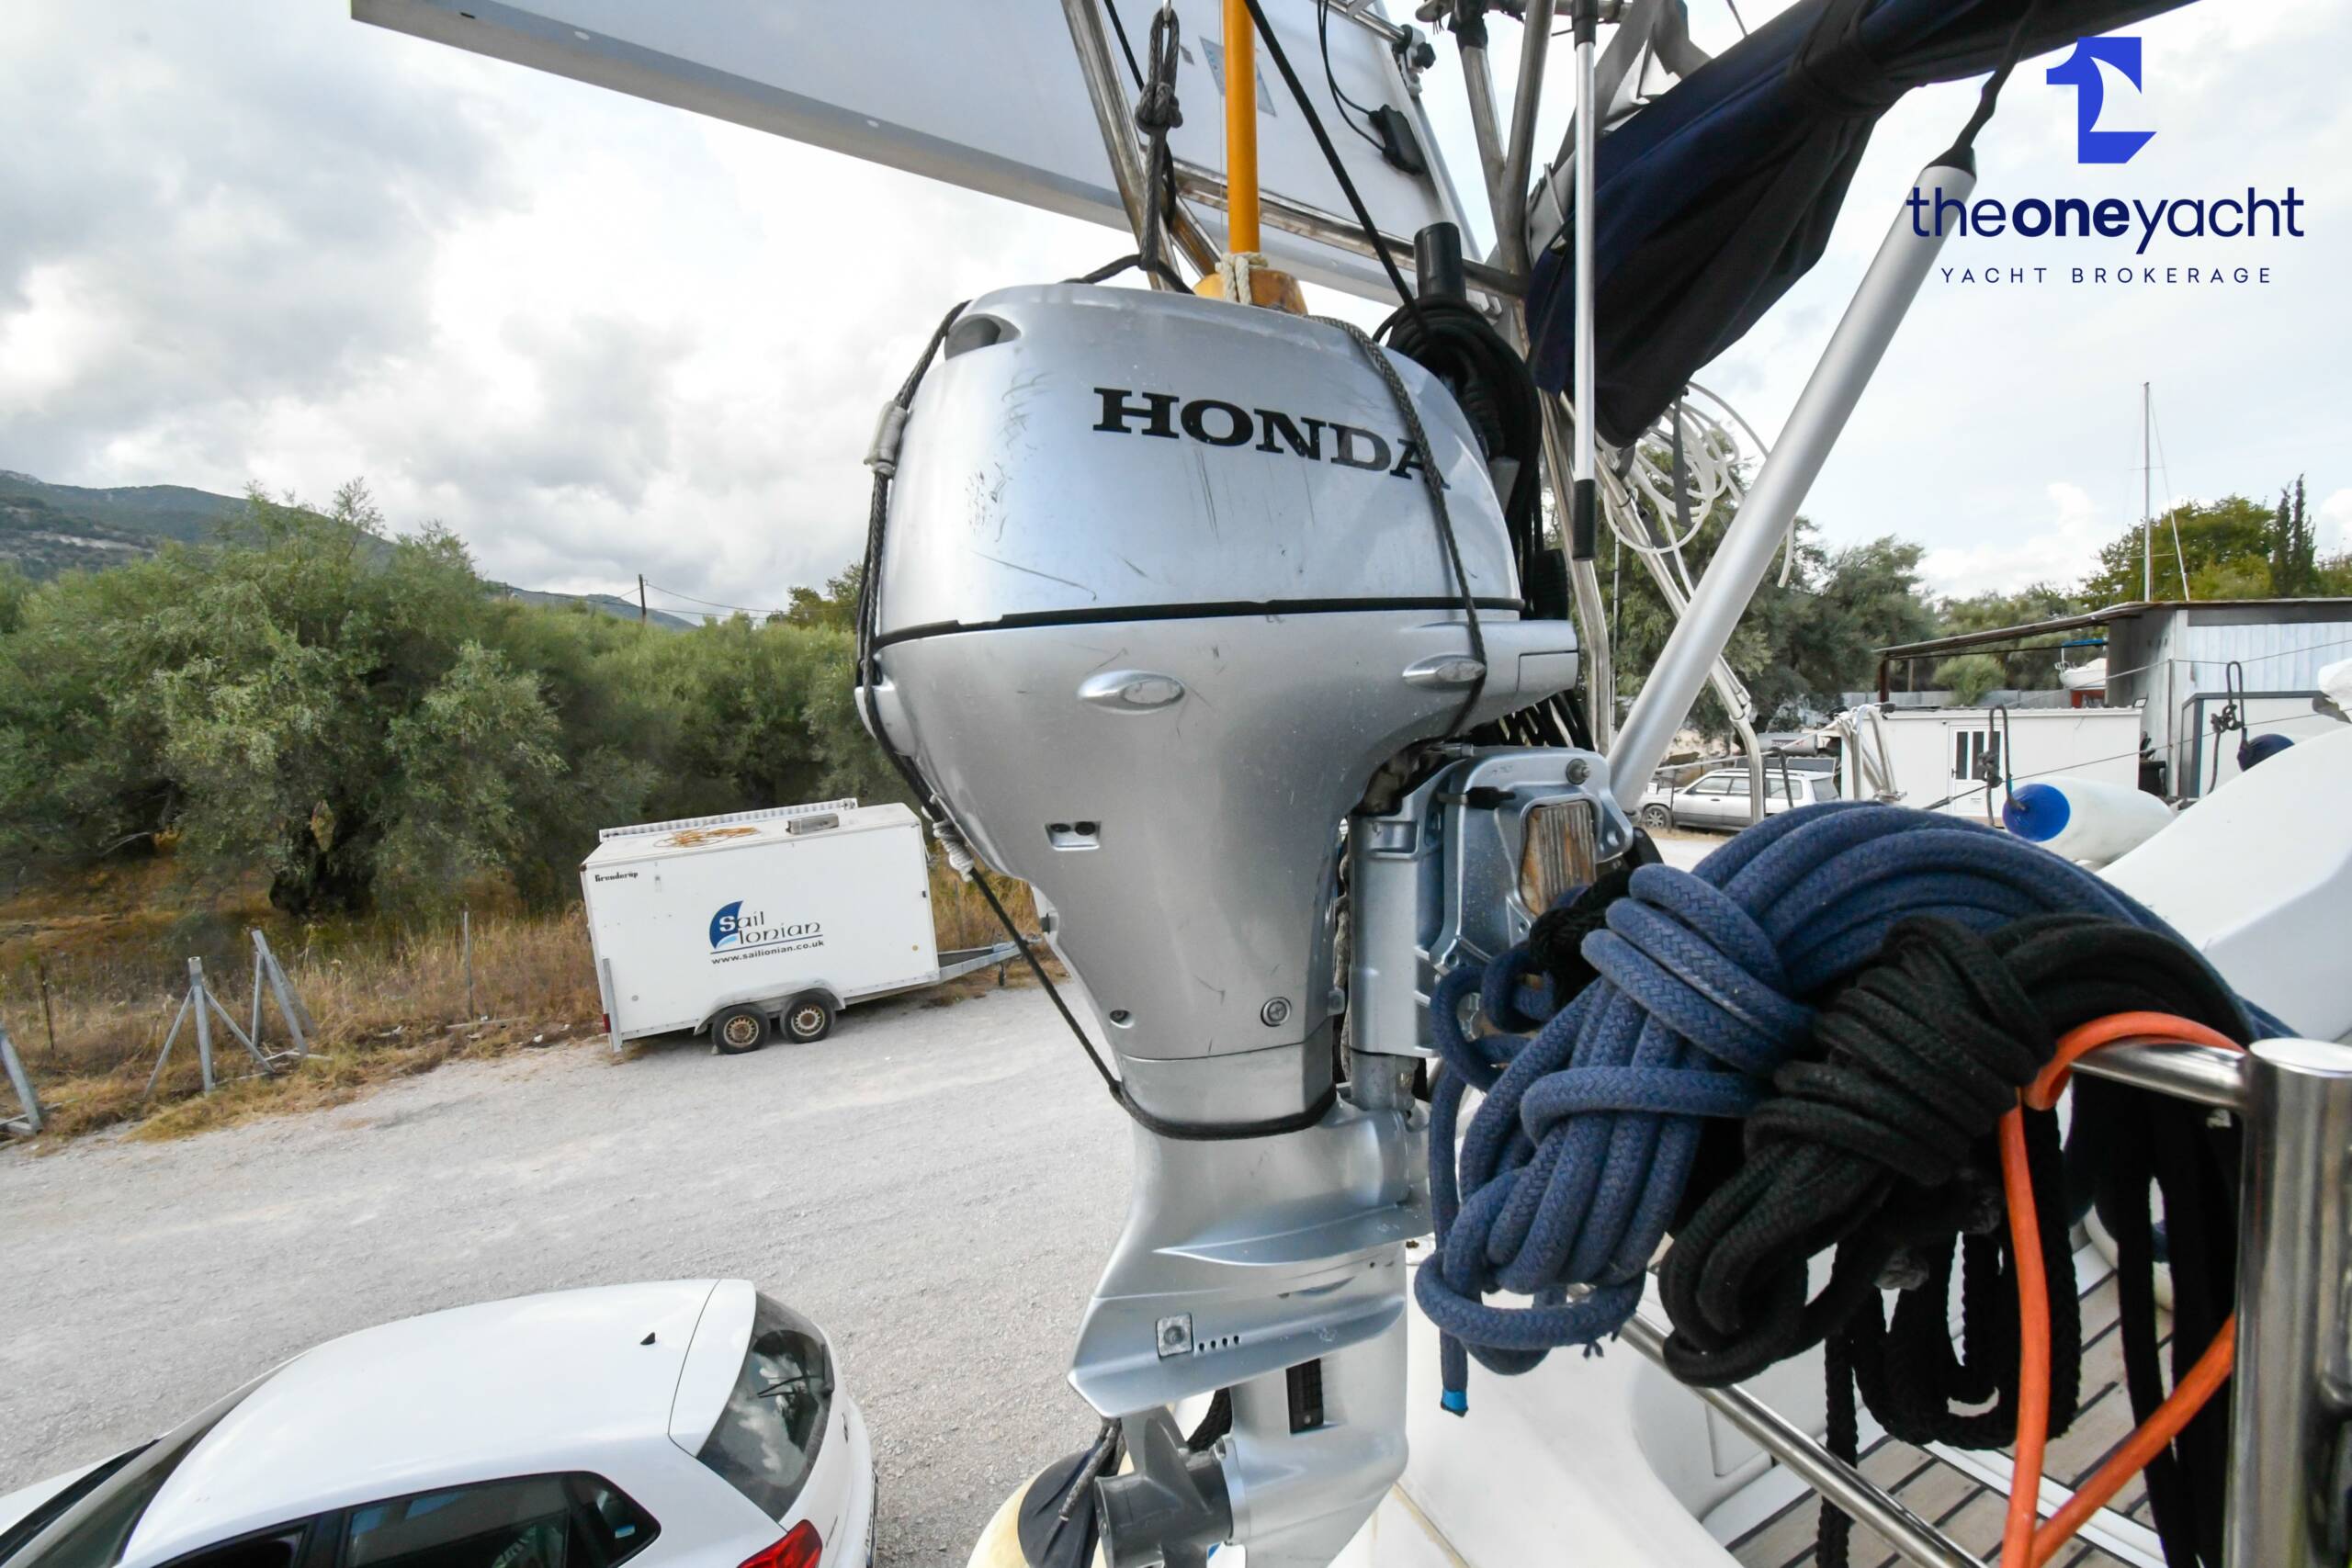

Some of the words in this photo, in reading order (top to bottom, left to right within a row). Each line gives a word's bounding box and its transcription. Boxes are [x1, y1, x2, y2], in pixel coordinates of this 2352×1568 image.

[719, 910, 764, 932] Sail
[739, 921, 820, 944] Ionian
[711, 940, 824, 964] www.sailionian.co.uk
